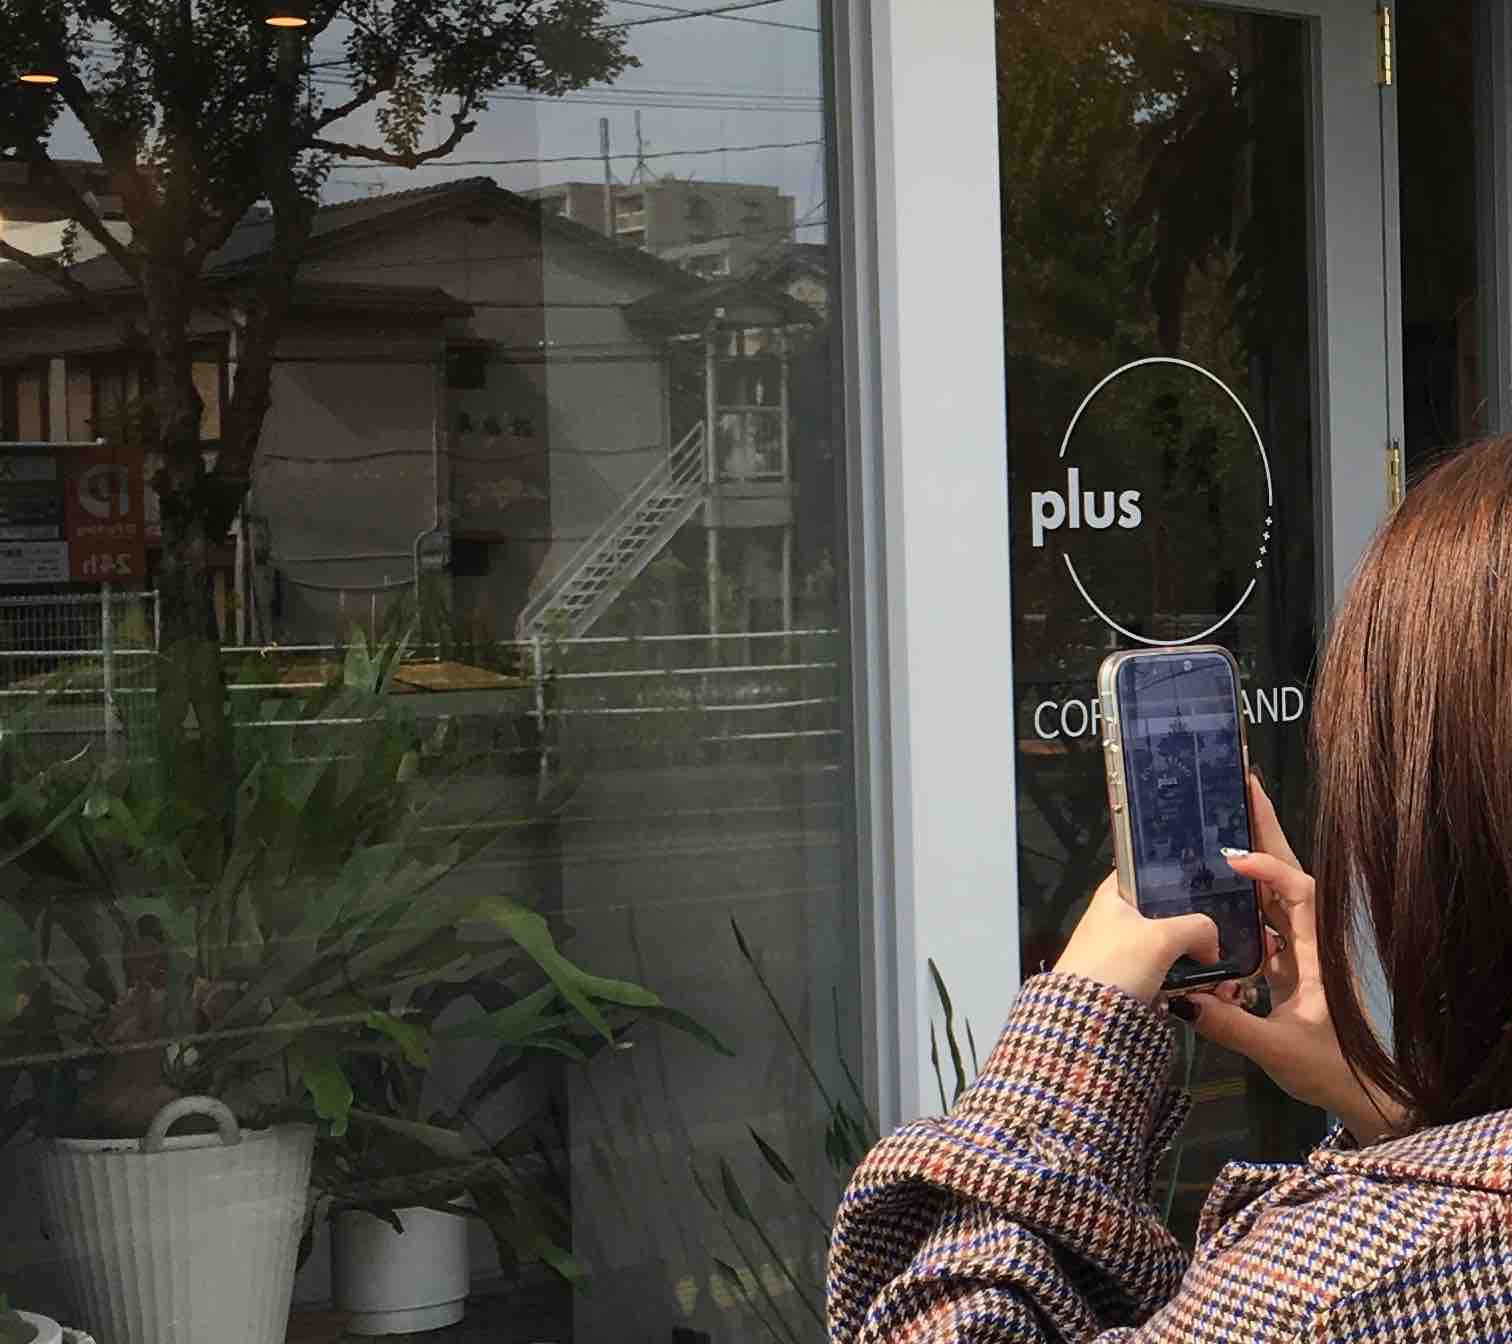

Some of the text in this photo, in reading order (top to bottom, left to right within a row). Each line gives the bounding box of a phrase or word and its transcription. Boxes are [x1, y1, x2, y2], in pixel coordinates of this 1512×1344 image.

[1031, 467, 1142, 547] plus
[1034, 686, 1304, 739] COF AND
